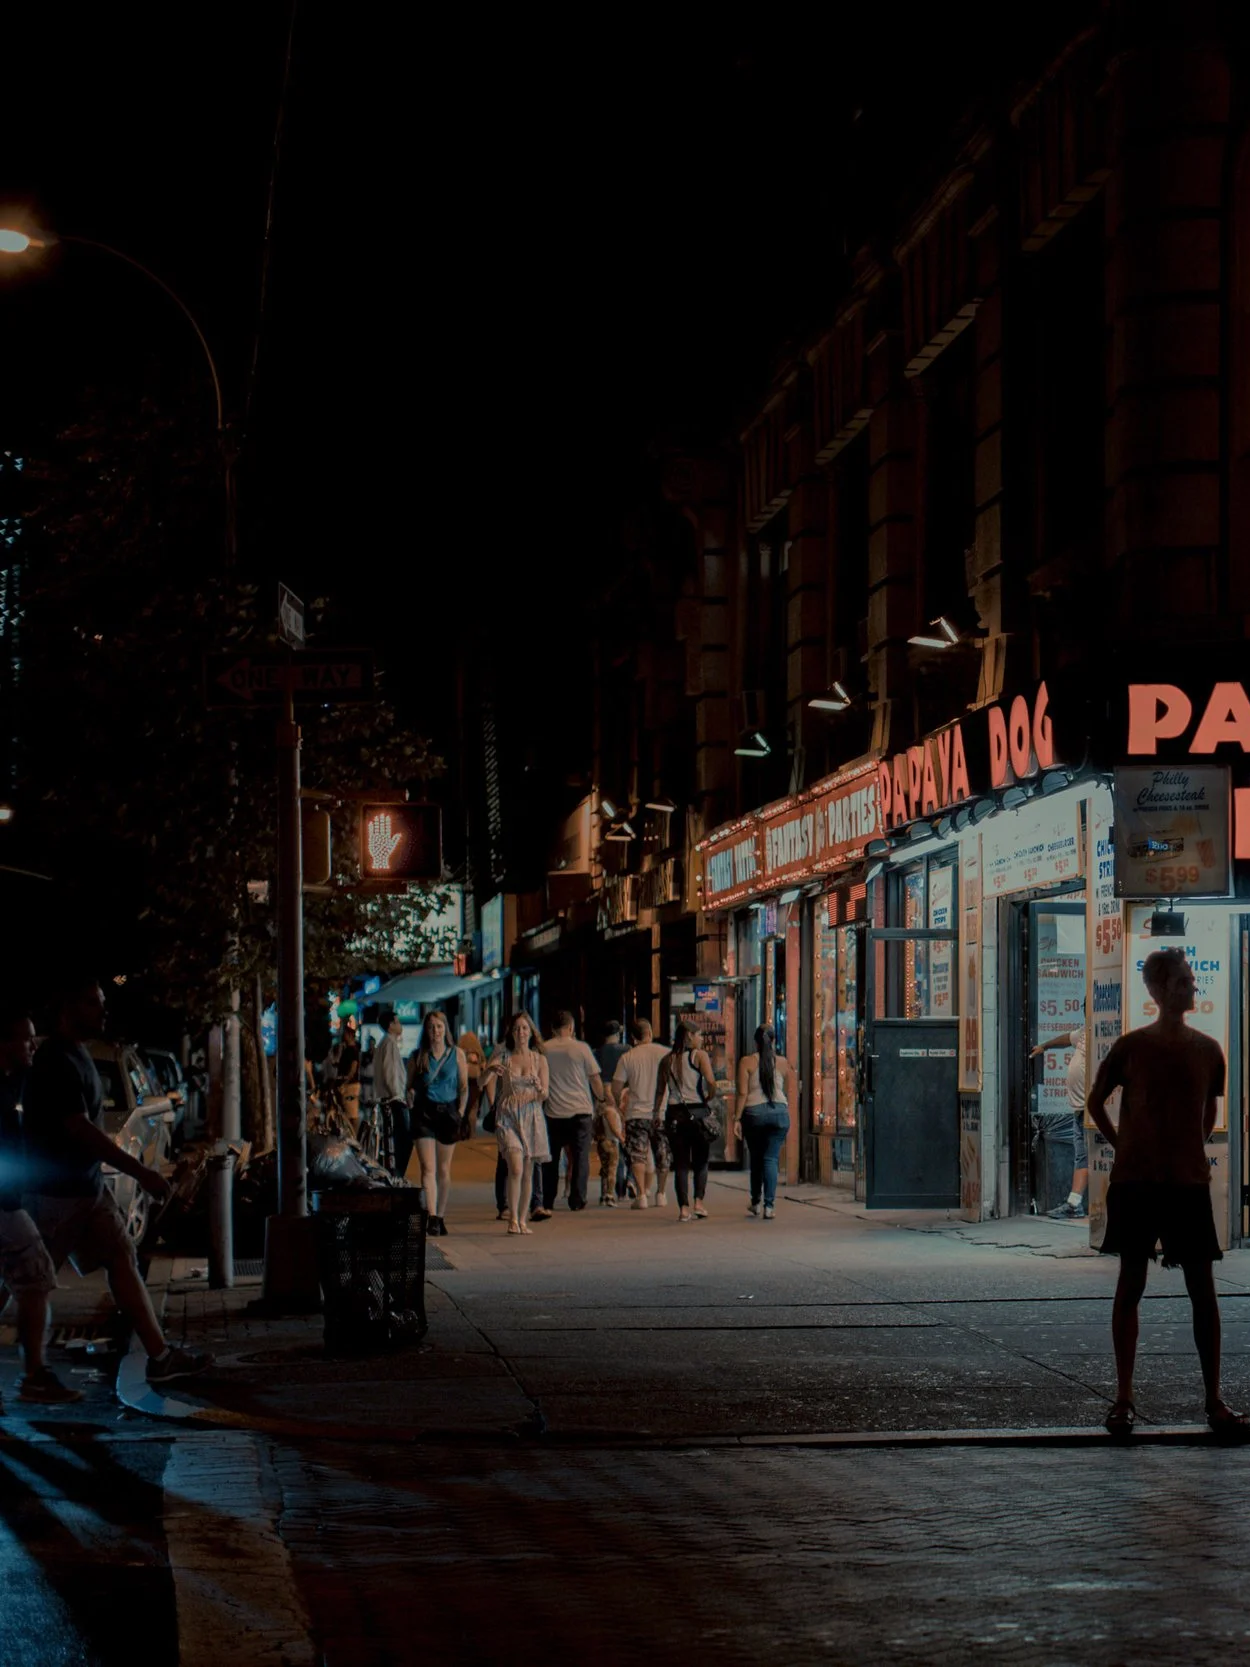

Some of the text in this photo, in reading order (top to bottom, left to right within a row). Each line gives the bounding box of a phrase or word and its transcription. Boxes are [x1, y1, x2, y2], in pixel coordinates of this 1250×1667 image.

[229, 665, 348, 689] ONE WAY
[879, 680, 1053, 830] PAPAYA DOG
[1152, 770, 1190, 789] Philly
[1136, 786, 1206, 805] Cheesesteak
[828, 783, 876, 847] PARTIES
[1145, 866, 1200, 892] $5.99
[1040, 999, 1081, 1017] $5.50
[1043, 1088, 1069, 1098] STRIP
